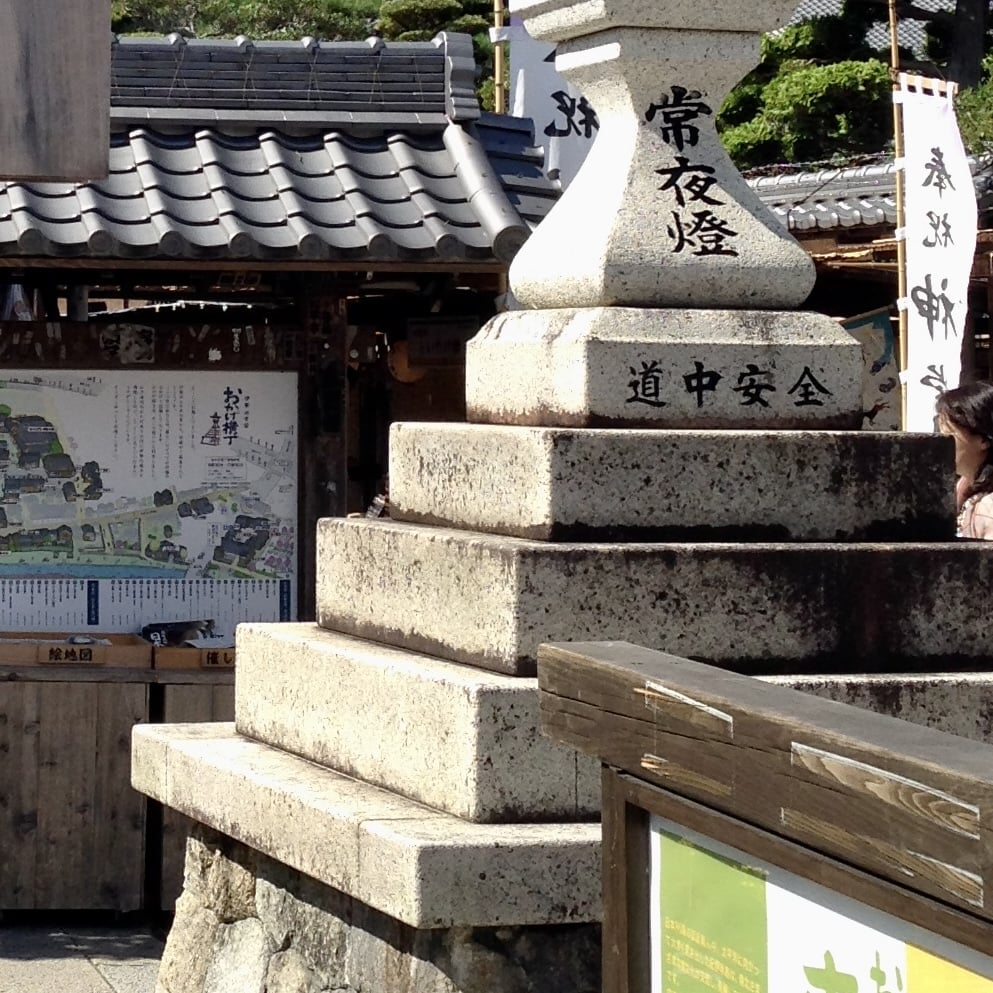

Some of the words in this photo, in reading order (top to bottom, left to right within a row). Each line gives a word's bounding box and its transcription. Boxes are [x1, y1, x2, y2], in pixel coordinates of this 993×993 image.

[645, 85, 738, 257] 常夜燈
[626, 361, 833, 407] 道中安全
[49, 648, 92, 662] 絵地図
